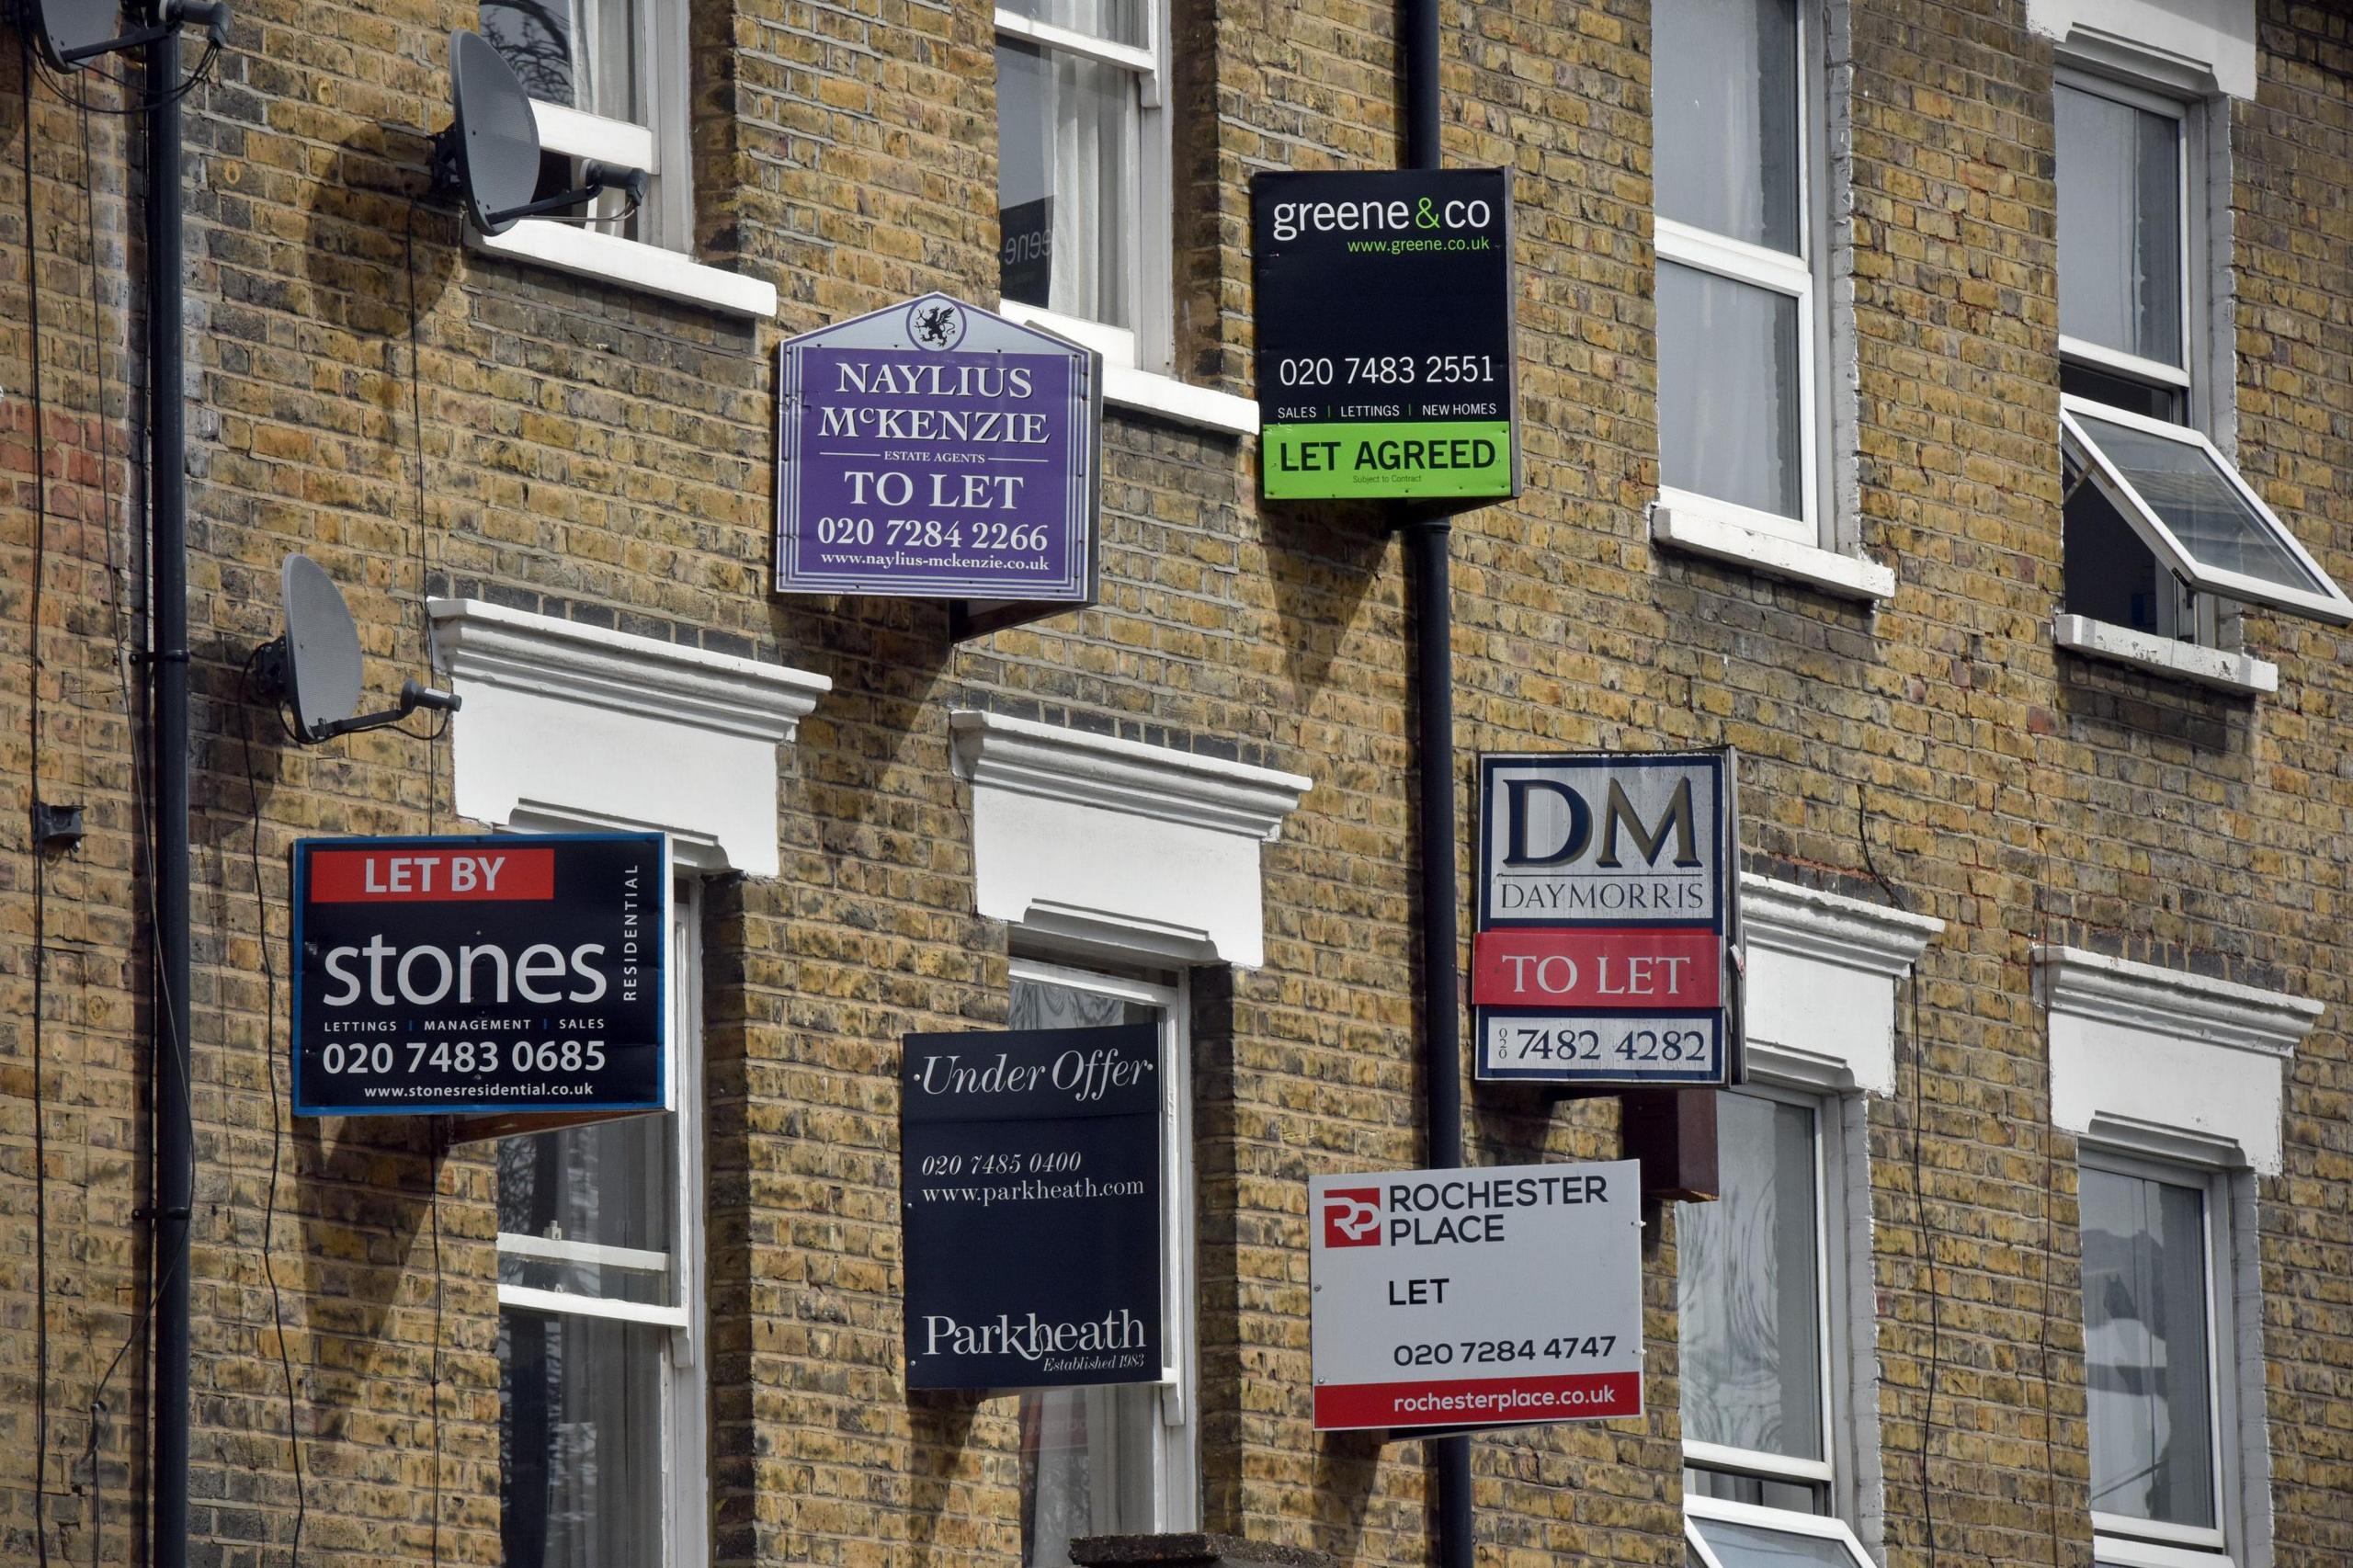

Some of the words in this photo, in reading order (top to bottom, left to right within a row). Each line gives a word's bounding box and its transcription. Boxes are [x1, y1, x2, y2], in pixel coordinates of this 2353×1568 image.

[1347, 236, 1490, 255] www.greene.co.uk
[835, 362, 1033, 399] NAYLIUS
[1279, 358, 1333, 385] 020
[1345, 357, 1415, 384] 7483
[1427, 356, 1494, 382] 2551
[1278, 406, 1316, 419] SALES
[1341, 405, 1400, 417] LETTINGS
[1422, 404, 1449, 415] NEW
[1453, 403, 1496, 415] HOMES
[884, 451, 930, 461] ESTATE
[934, 452, 985, 463] AGENTS
[1280, 442, 1341, 472] LET
[1354, 439, 1496, 470] AGREED
[845, 471, 914, 506] TO
[929, 473, 1024, 509] LET
[1353, 475, 1380, 484] Subject
[1392, 474, 1421, 483] Contract
[817, 517, 874, 545] 020
[886, 519, 962, 549] 7284
[972, 522, 1048, 551] 2266
[820, 551, 1050, 571] www.naylius-mckenzie.co.uk
[1503, 776, 1703, 869] DM
[365, 858, 439, 893] LET
[451, 857, 506, 891] BY
[623, 865, 639, 1001] RESIDENTIAL
[323, 934, 608, 1006] stones
[1502, 955, 1578, 994] TO
[1597, 956, 1690, 994] LET
[324, 1021, 397, 1032] LETTINGS
[424, 1019, 531, 1031] MANAGEMENT
[559, 1018, 605, 1029] SALES
[323, 1042, 393, 1074] 020
[406, 1041, 498, 1073] 7483
[512, 1040, 606, 1072] 0685
[1518, 1028, 1601, 1060] 7482
[1614, 1029, 1705, 1061] 4282
[364, 1083, 593, 1097] www.stonesresidential.co.uk
[923, 1053, 1045, 1095] Under
[1052, 1048, 1148, 1101] Offer
[922, 1155, 961, 1176] 020
[971, 1153, 1021, 1175] 7485
[1029, 1152, 1081, 1173] 0400
[923, 1178, 1144, 1206] www.parkheath.com
[1390, 1176, 1608, 1212] ROCHESTER
[1391, 1214, 1505, 1246] PLACE
[1389, 1278, 1449, 1306] LET
[922, 1308, 1147, 1360] Parkheath
[1043, 1355, 1116, 1371] Established
[1119, 1353, 1144, 1368] 1983
[1393, 1343, 1453, 1367] 020
[1461, 1339, 1536, 1363] 7284
[1543, 1335, 1616, 1360] 4747
[1393, 1384, 1616, 1413] rochesterplace.co.uk
